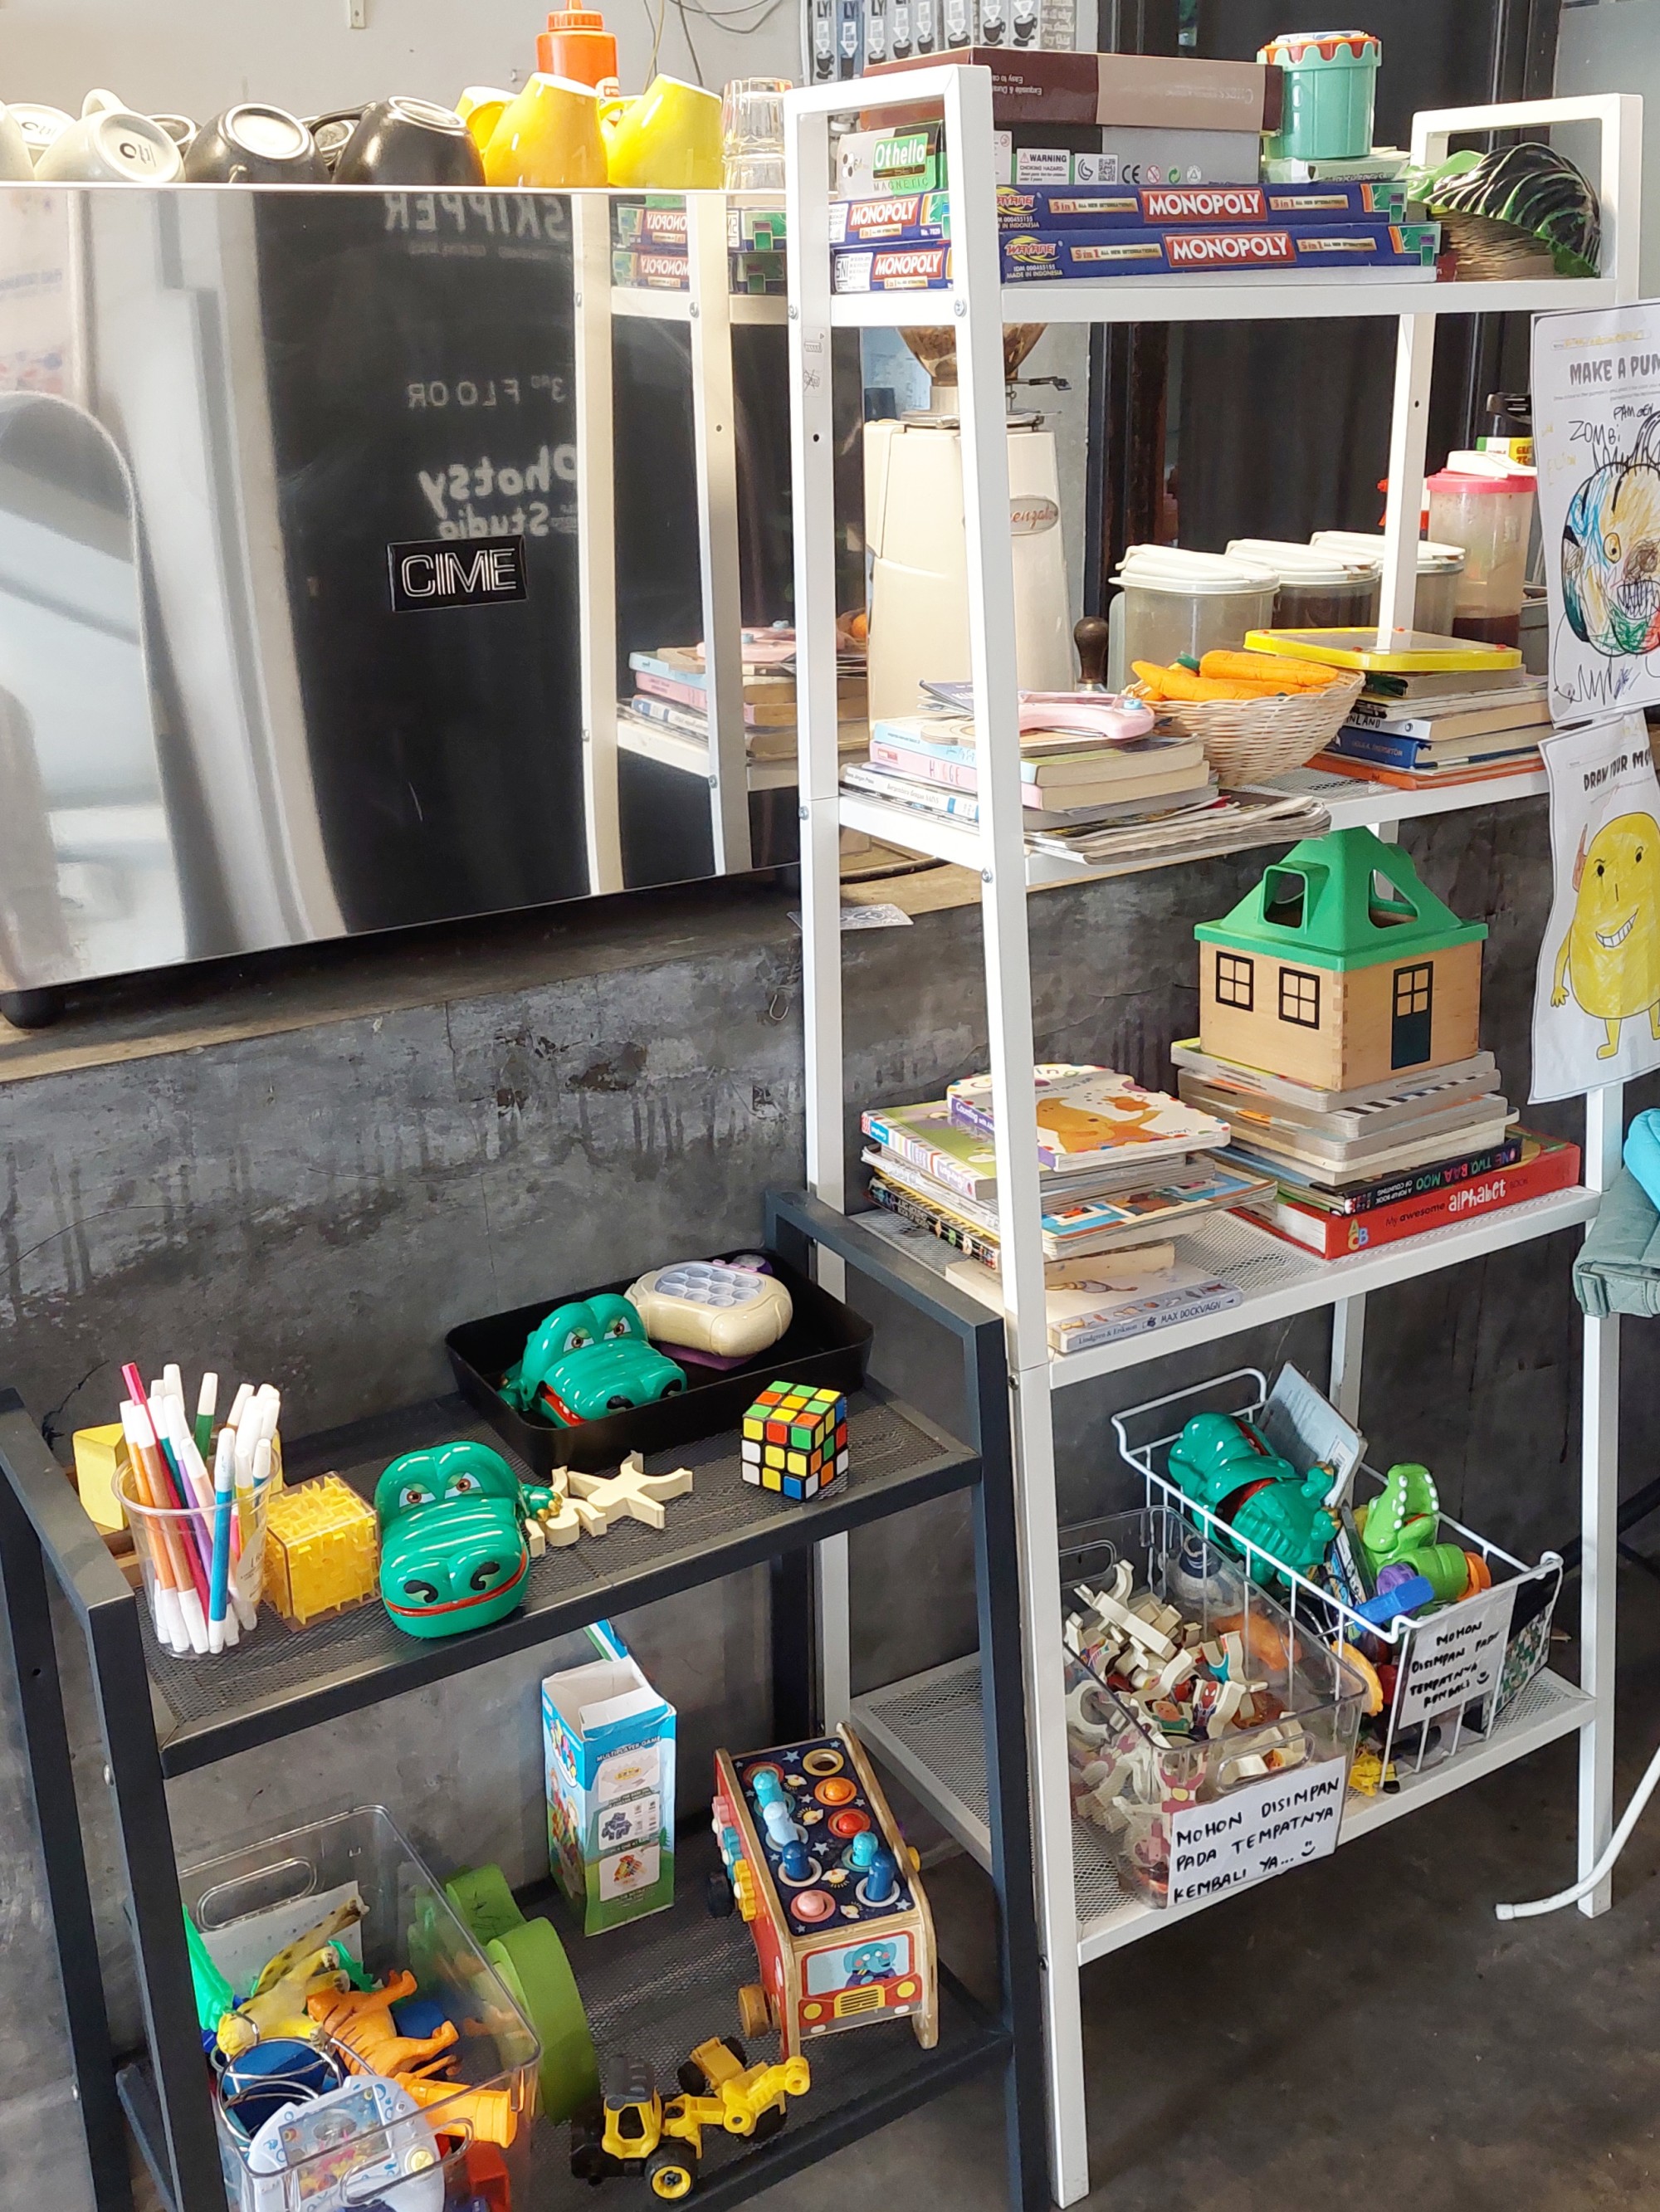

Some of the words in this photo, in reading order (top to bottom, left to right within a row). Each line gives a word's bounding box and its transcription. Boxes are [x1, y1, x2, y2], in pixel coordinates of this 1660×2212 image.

[875, 139, 925, 168] Othello
[1030, 154, 1067, 163] WARNING
[873, 177, 930, 192] MAGNETIC
[850, 199, 918, 227] MONOPOLY
[1061, 202, 1072, 211] in
[1148, 193, 1260, 216] MONOPOLY
[1281, 199, 1288, 208] in
[1005, 243, 1057, 256] WAYANG
[1083, 251, 1094, 259] in
[1173, 236, 1288, 261] MONOPOLY
[1308, 242, 1316, 250] in
[836, 257, 849, 279] SNI
[875, 254, 941, 276] MONOPOLY
[1570, 359, 1613, 386] MAKE
[1618, 358, 1626, 379] A
[401, 548, 517, 598] CIME
[955, 1101, 979, 1124] Counting
[1496, 1146, 1517, 1164] ONE
[1416, 1170, 1441, 1191] MOO
[1443, 1164, 1469, 1183] BAA
[1399, 1203, 1445, 1222] awesome
[1161, 1310, 1178, 1324] MAX
[1179, 1300, 1222, 1319] DOCKVAGN
[1436, 1621, 1482, 1647] MOHON
[1411, 1647, 1465, 1674] DISIMPAN
[1409, 1662, 1477, 1696] TEMPATNYA
[596, 1741, 641, 1762] MULTIPLAYER
[641, 1735, 662, 1747] GAME
[1176, 1811, 1243, 1848] MOHON
[1261, 1777, 1340, 1819] DISIMPAN
[1176, 1848, 1217, 1873] PADA
[1231, 1806, 1334, 1855] TEMPATNYA
[1174, 1868, 1247, 1903] KEMBALI
